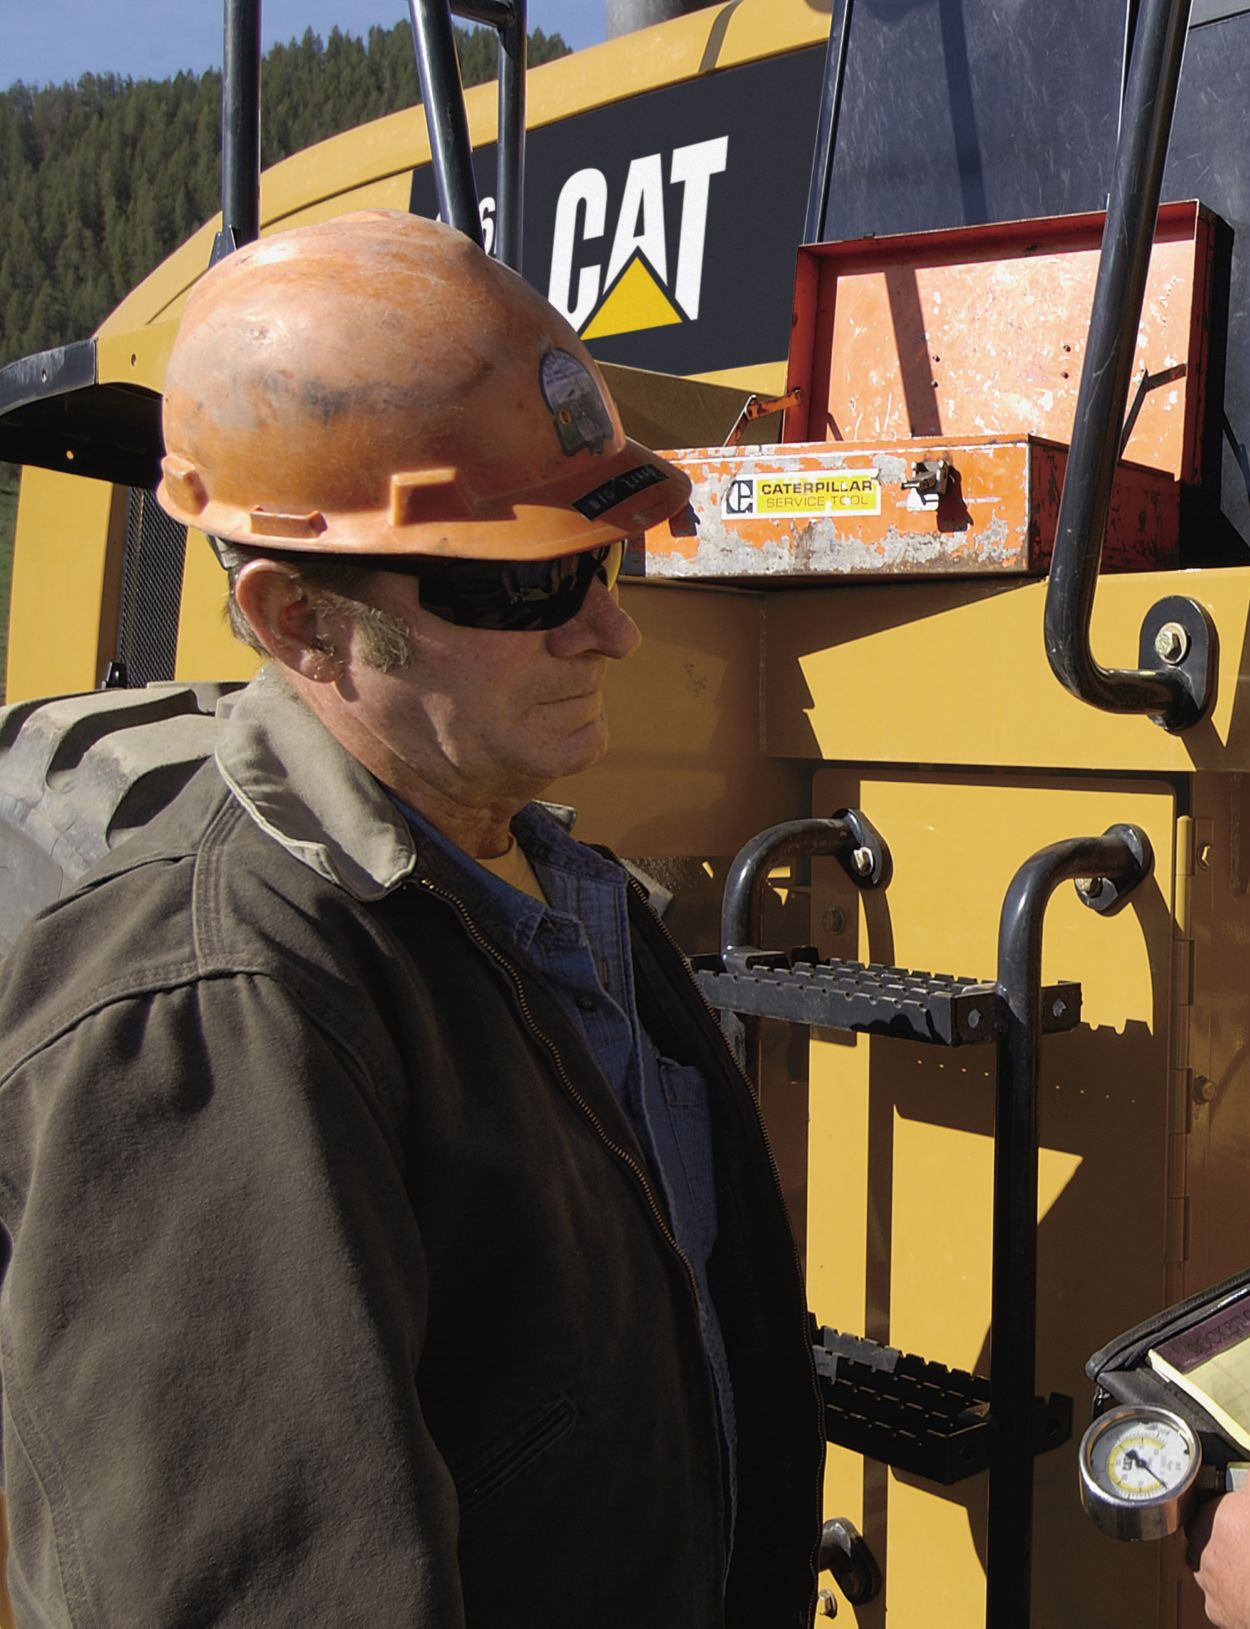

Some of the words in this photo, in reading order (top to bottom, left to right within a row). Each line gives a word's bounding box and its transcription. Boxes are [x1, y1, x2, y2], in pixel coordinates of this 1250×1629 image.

[548, 135, 729, 333] CAT
[761, 480, 873, 495] CATERPILLAR
[766, 495, 825, 509] SERVICE
